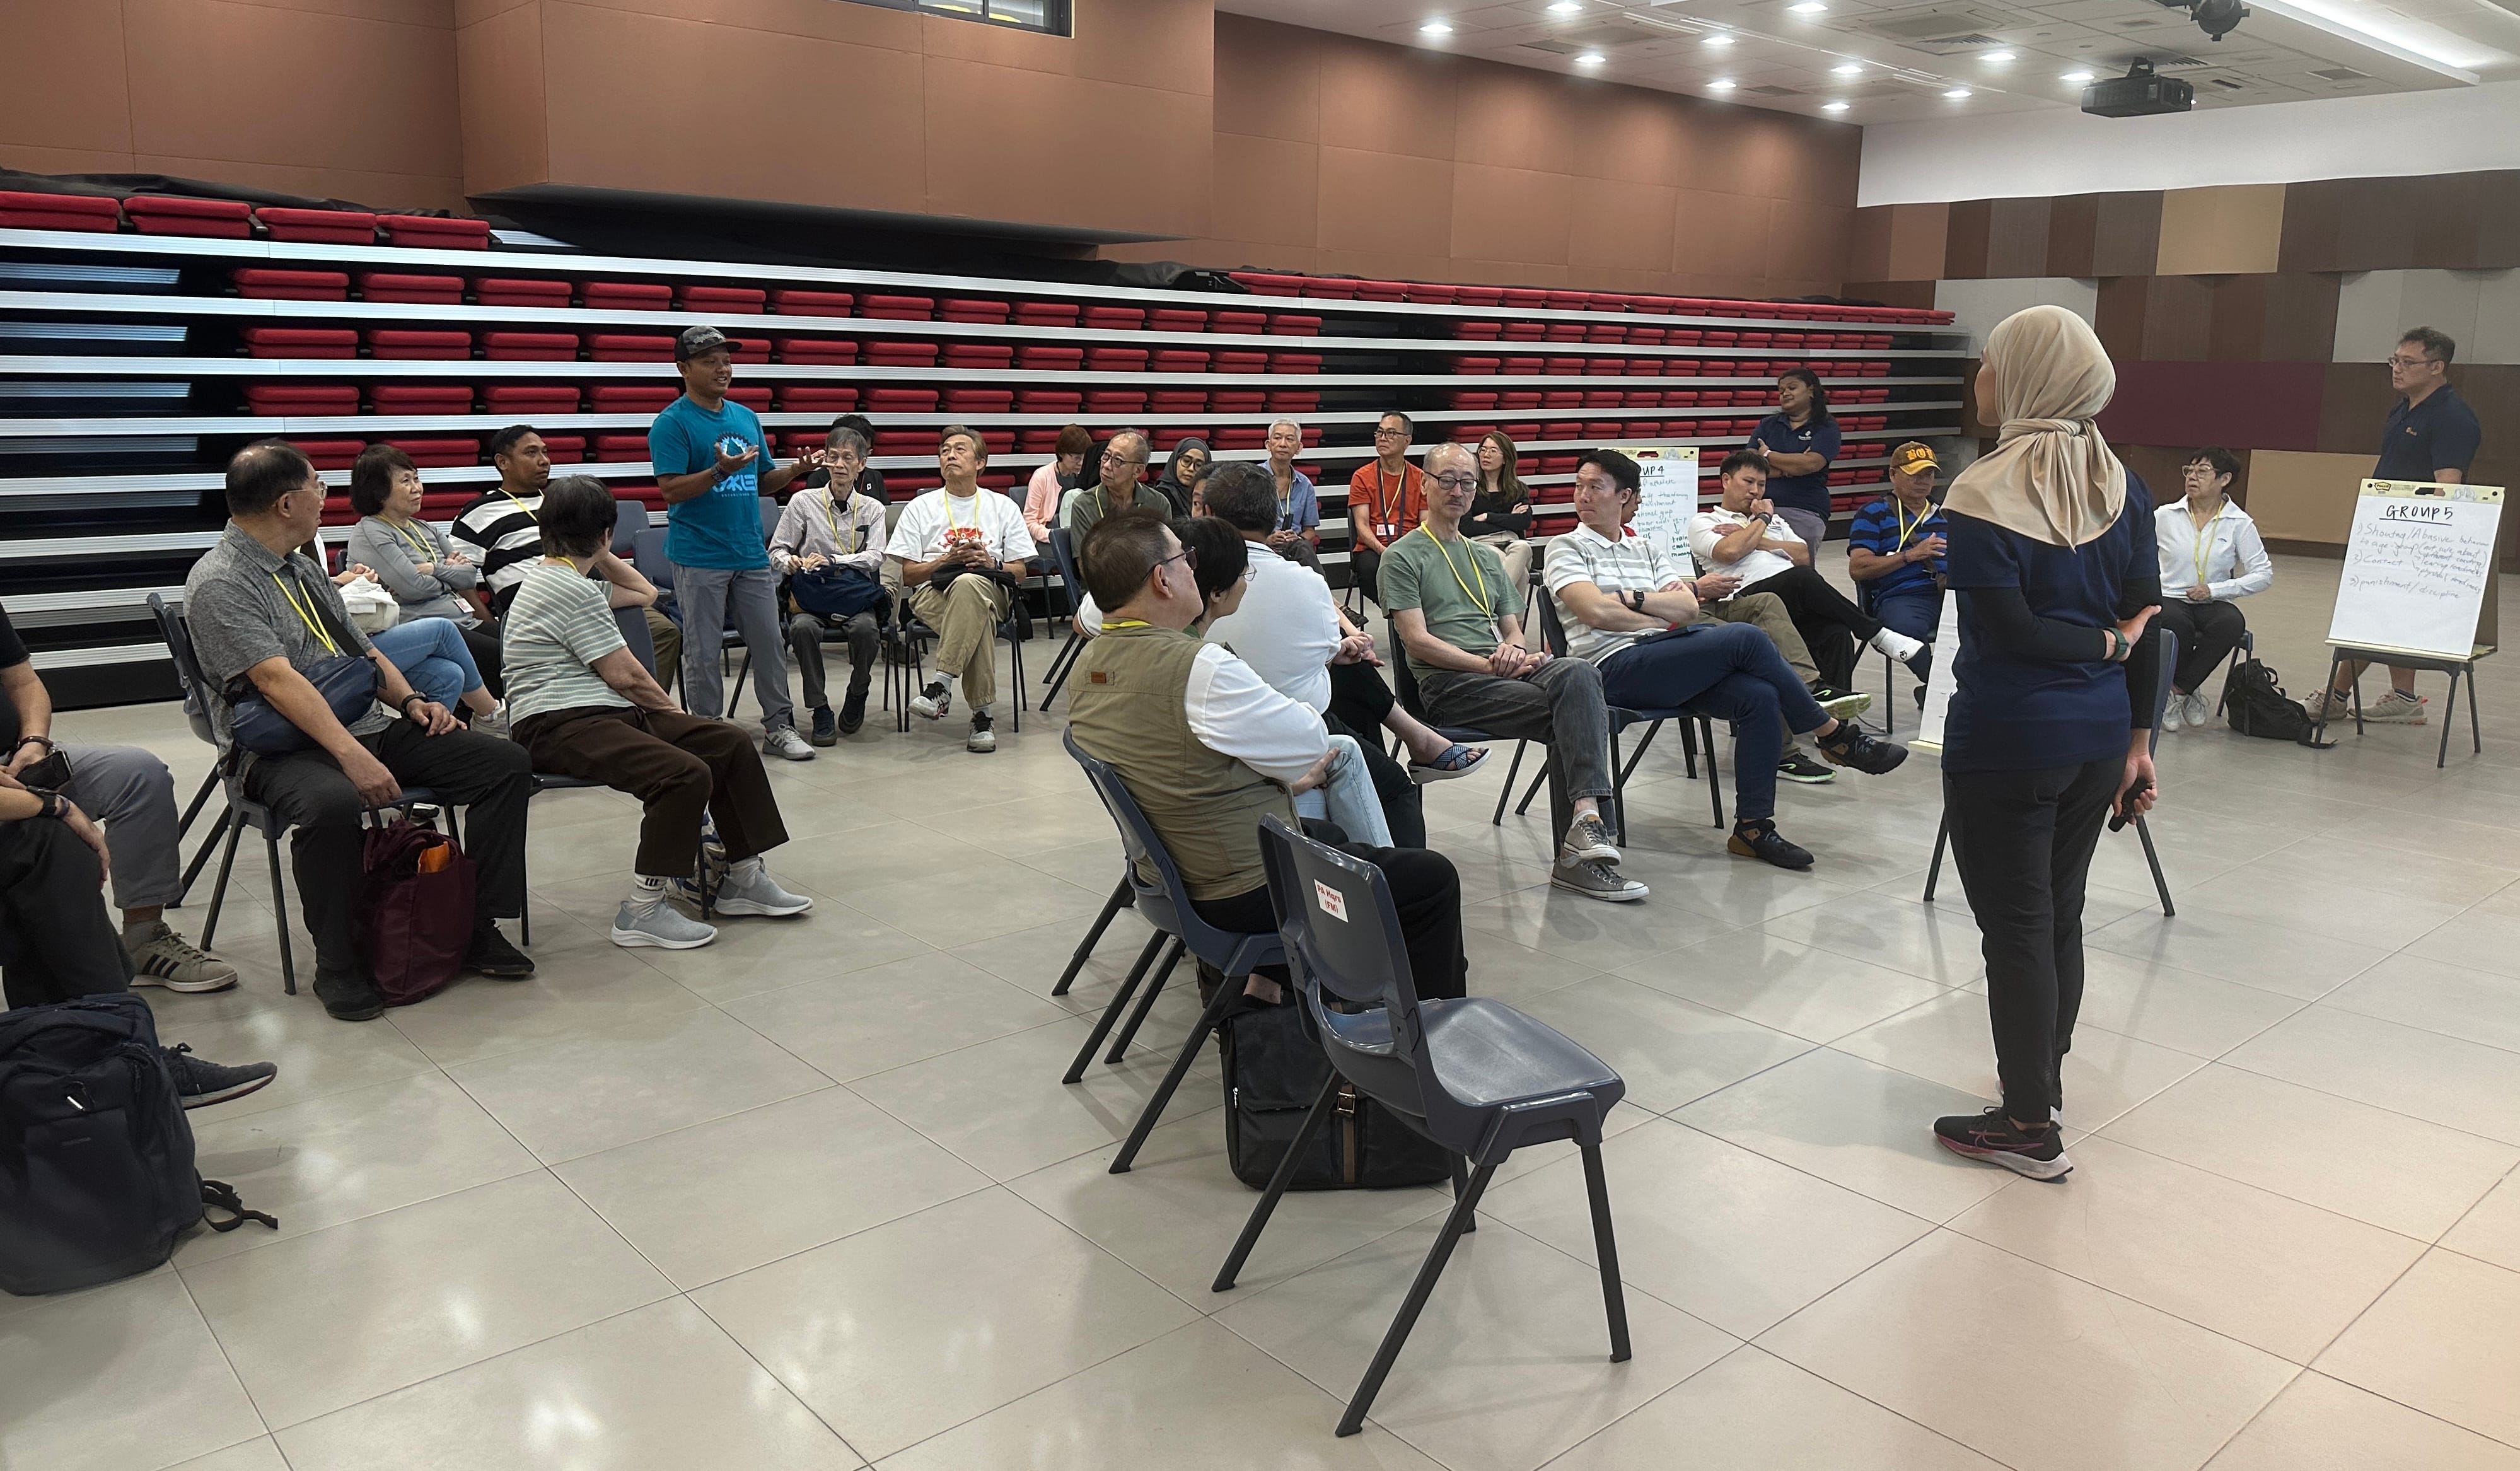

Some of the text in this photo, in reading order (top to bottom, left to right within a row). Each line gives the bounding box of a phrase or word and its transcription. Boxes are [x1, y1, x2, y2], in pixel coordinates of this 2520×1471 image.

[1642, 465, 1664, 475] UP 4
[2386, 504, 2453, 521] GROUP 5
[2363, 555, 2403, 566] Contact
[1317, 884, 1325, 895] PA
